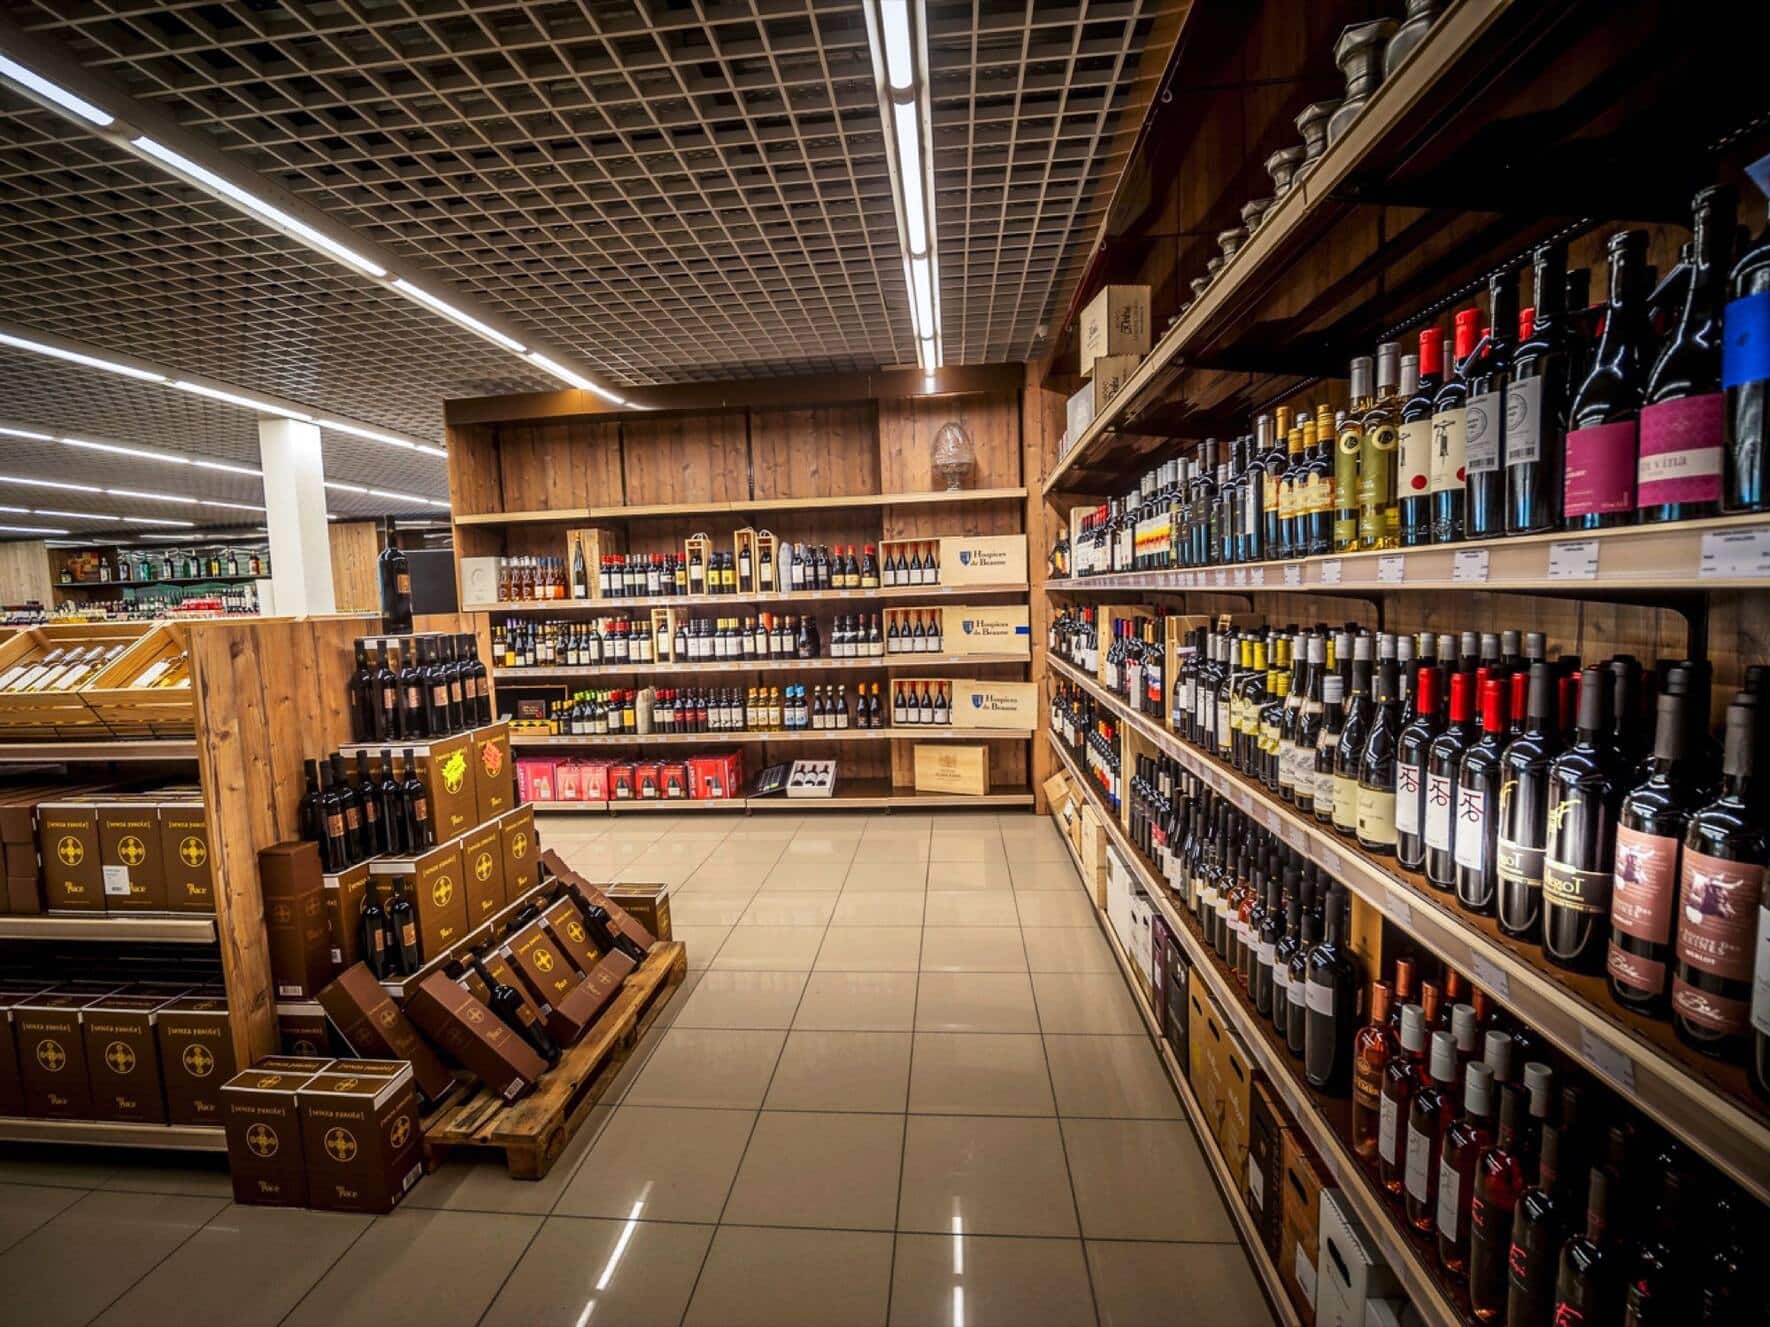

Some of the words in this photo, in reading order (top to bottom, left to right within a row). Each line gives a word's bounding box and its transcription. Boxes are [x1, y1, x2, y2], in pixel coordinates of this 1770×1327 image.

[973, 550, 1006, 559] Hospices
[976, 620, 1008, 628] Hospices
[986, 694, 1017, 704] Hospices
